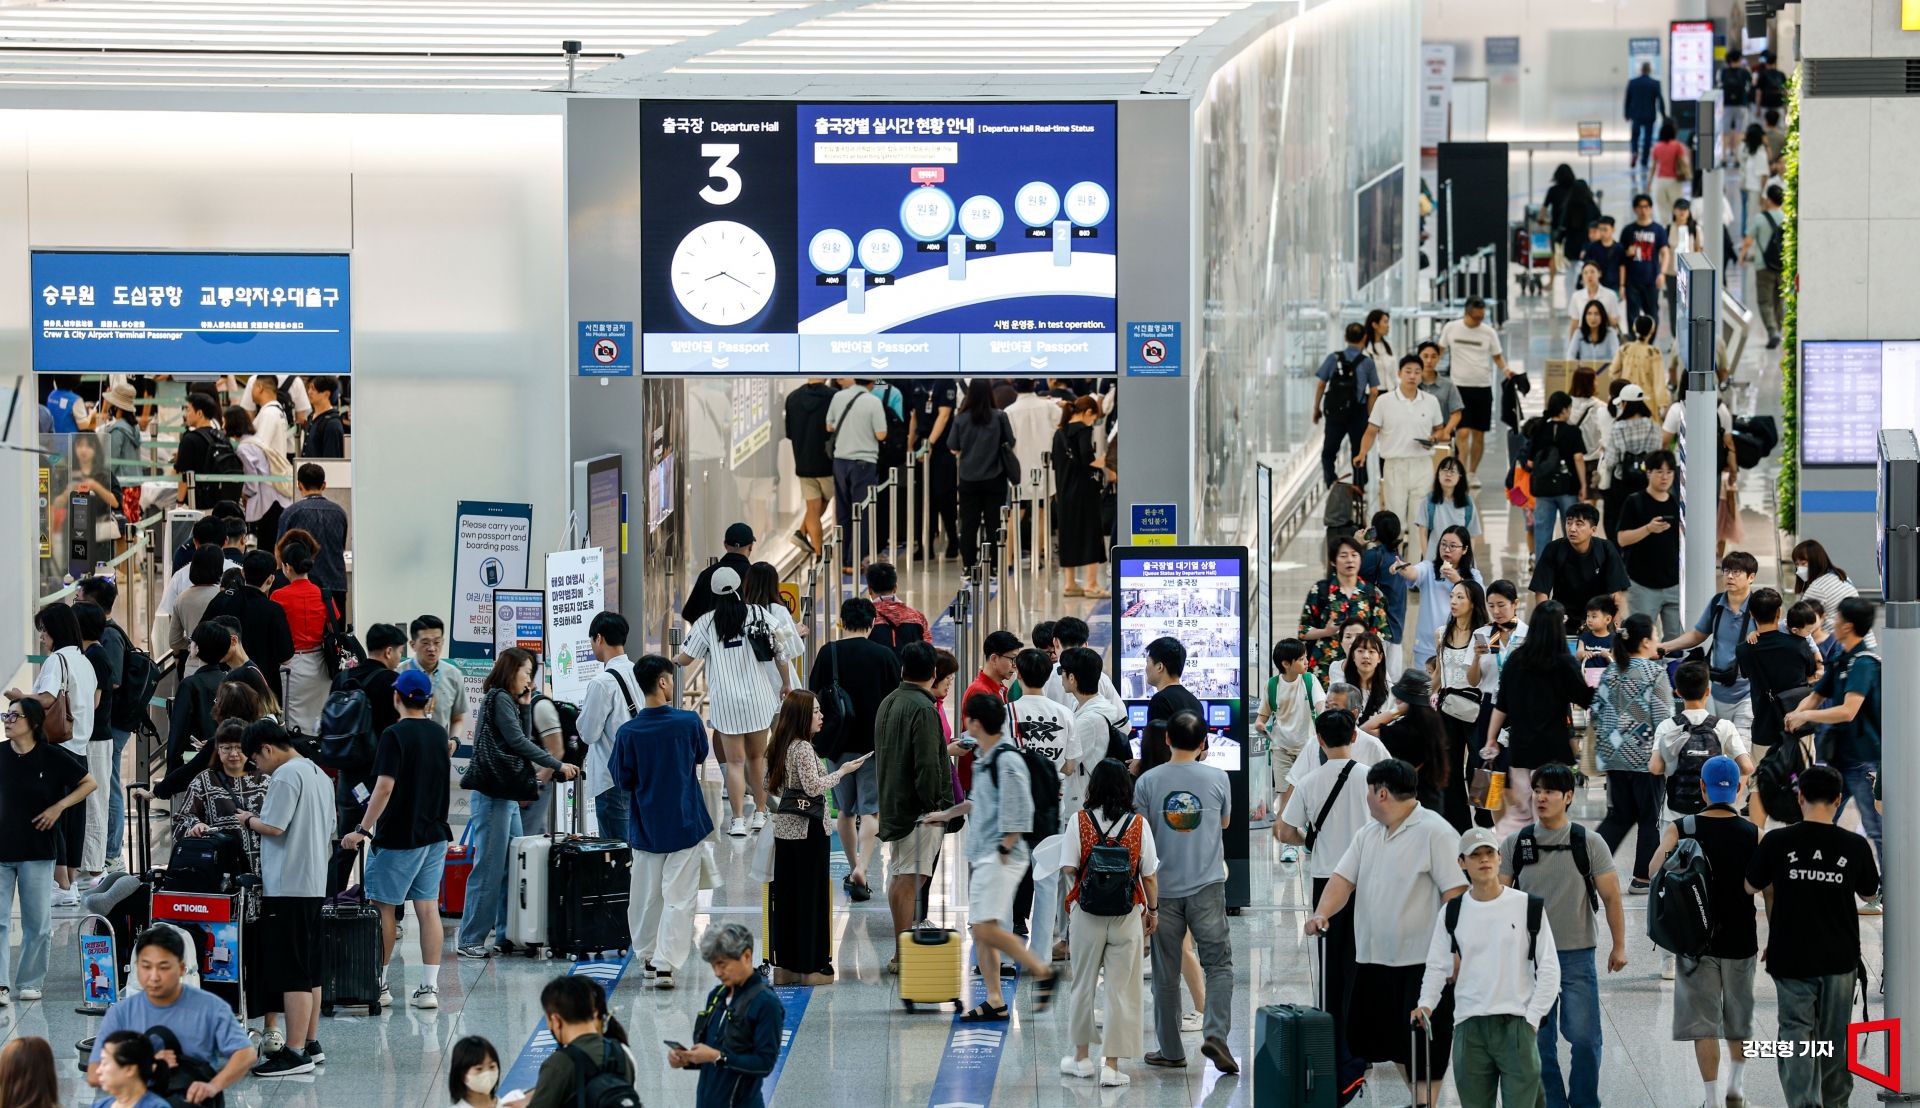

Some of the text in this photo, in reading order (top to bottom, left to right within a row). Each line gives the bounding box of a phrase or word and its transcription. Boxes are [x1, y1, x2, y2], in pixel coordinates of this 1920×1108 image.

[663, 117, 779, 134] 출국장 Departure Hall
[815, 117, 870, 134] 출국장별
[873, 117, 914, 134] 실시간
[916, 117, 944, 134] 현황
[946, 117, 975, 134] 안내
[982, 125, 1019, 134] Departure
[1020, 125, 1034, 133] Hall
[1071, 125, 1095, 133] Status
[698, 143, 742, 206] 3
[918, 204, 938, 216] 원활
[1057, 229, 1066, 241] 2
[952, 243, 961, 255] 3
[851, 277, 860, 289] 4
[43, 285, 95, 306] 승무원
[113, 286, 183, 307] 도심공항
[1039, 321, 1047, 329] In
[1048, 321, 1065, 329] test
[1065, 321, 1105, 330] operation.
[43, 330, 183, 341] Crew & City Airport Terminal Passenger
[671, 340, 770, 354] 일반여권 Passport
[830, 340, 929, 354] 일반여권 Passport
[989, 340, 1089, 354] 일반여권 Passport
[462, 520, 527, 532] Please carry your
[477, 533, 511, 542] passport
[512, 534, 527, 542] and
[466, 542, 499, 553] boarding
[1143, 561, 1217, 571] 출국장별 대기열 상황
[565, 573, 585, 586] 여행시
[1163, 579, 1198, 587] 2번 출국장
[551, 588, 584, 602] 마약범죄에
[469, 615, 492, 624] 본인이
[553, 614, 582, 627] 주의하세요
[1163, 619, 1198, 628] 4번 출국장
[1789, 869, 1844, 884] STUDIO
